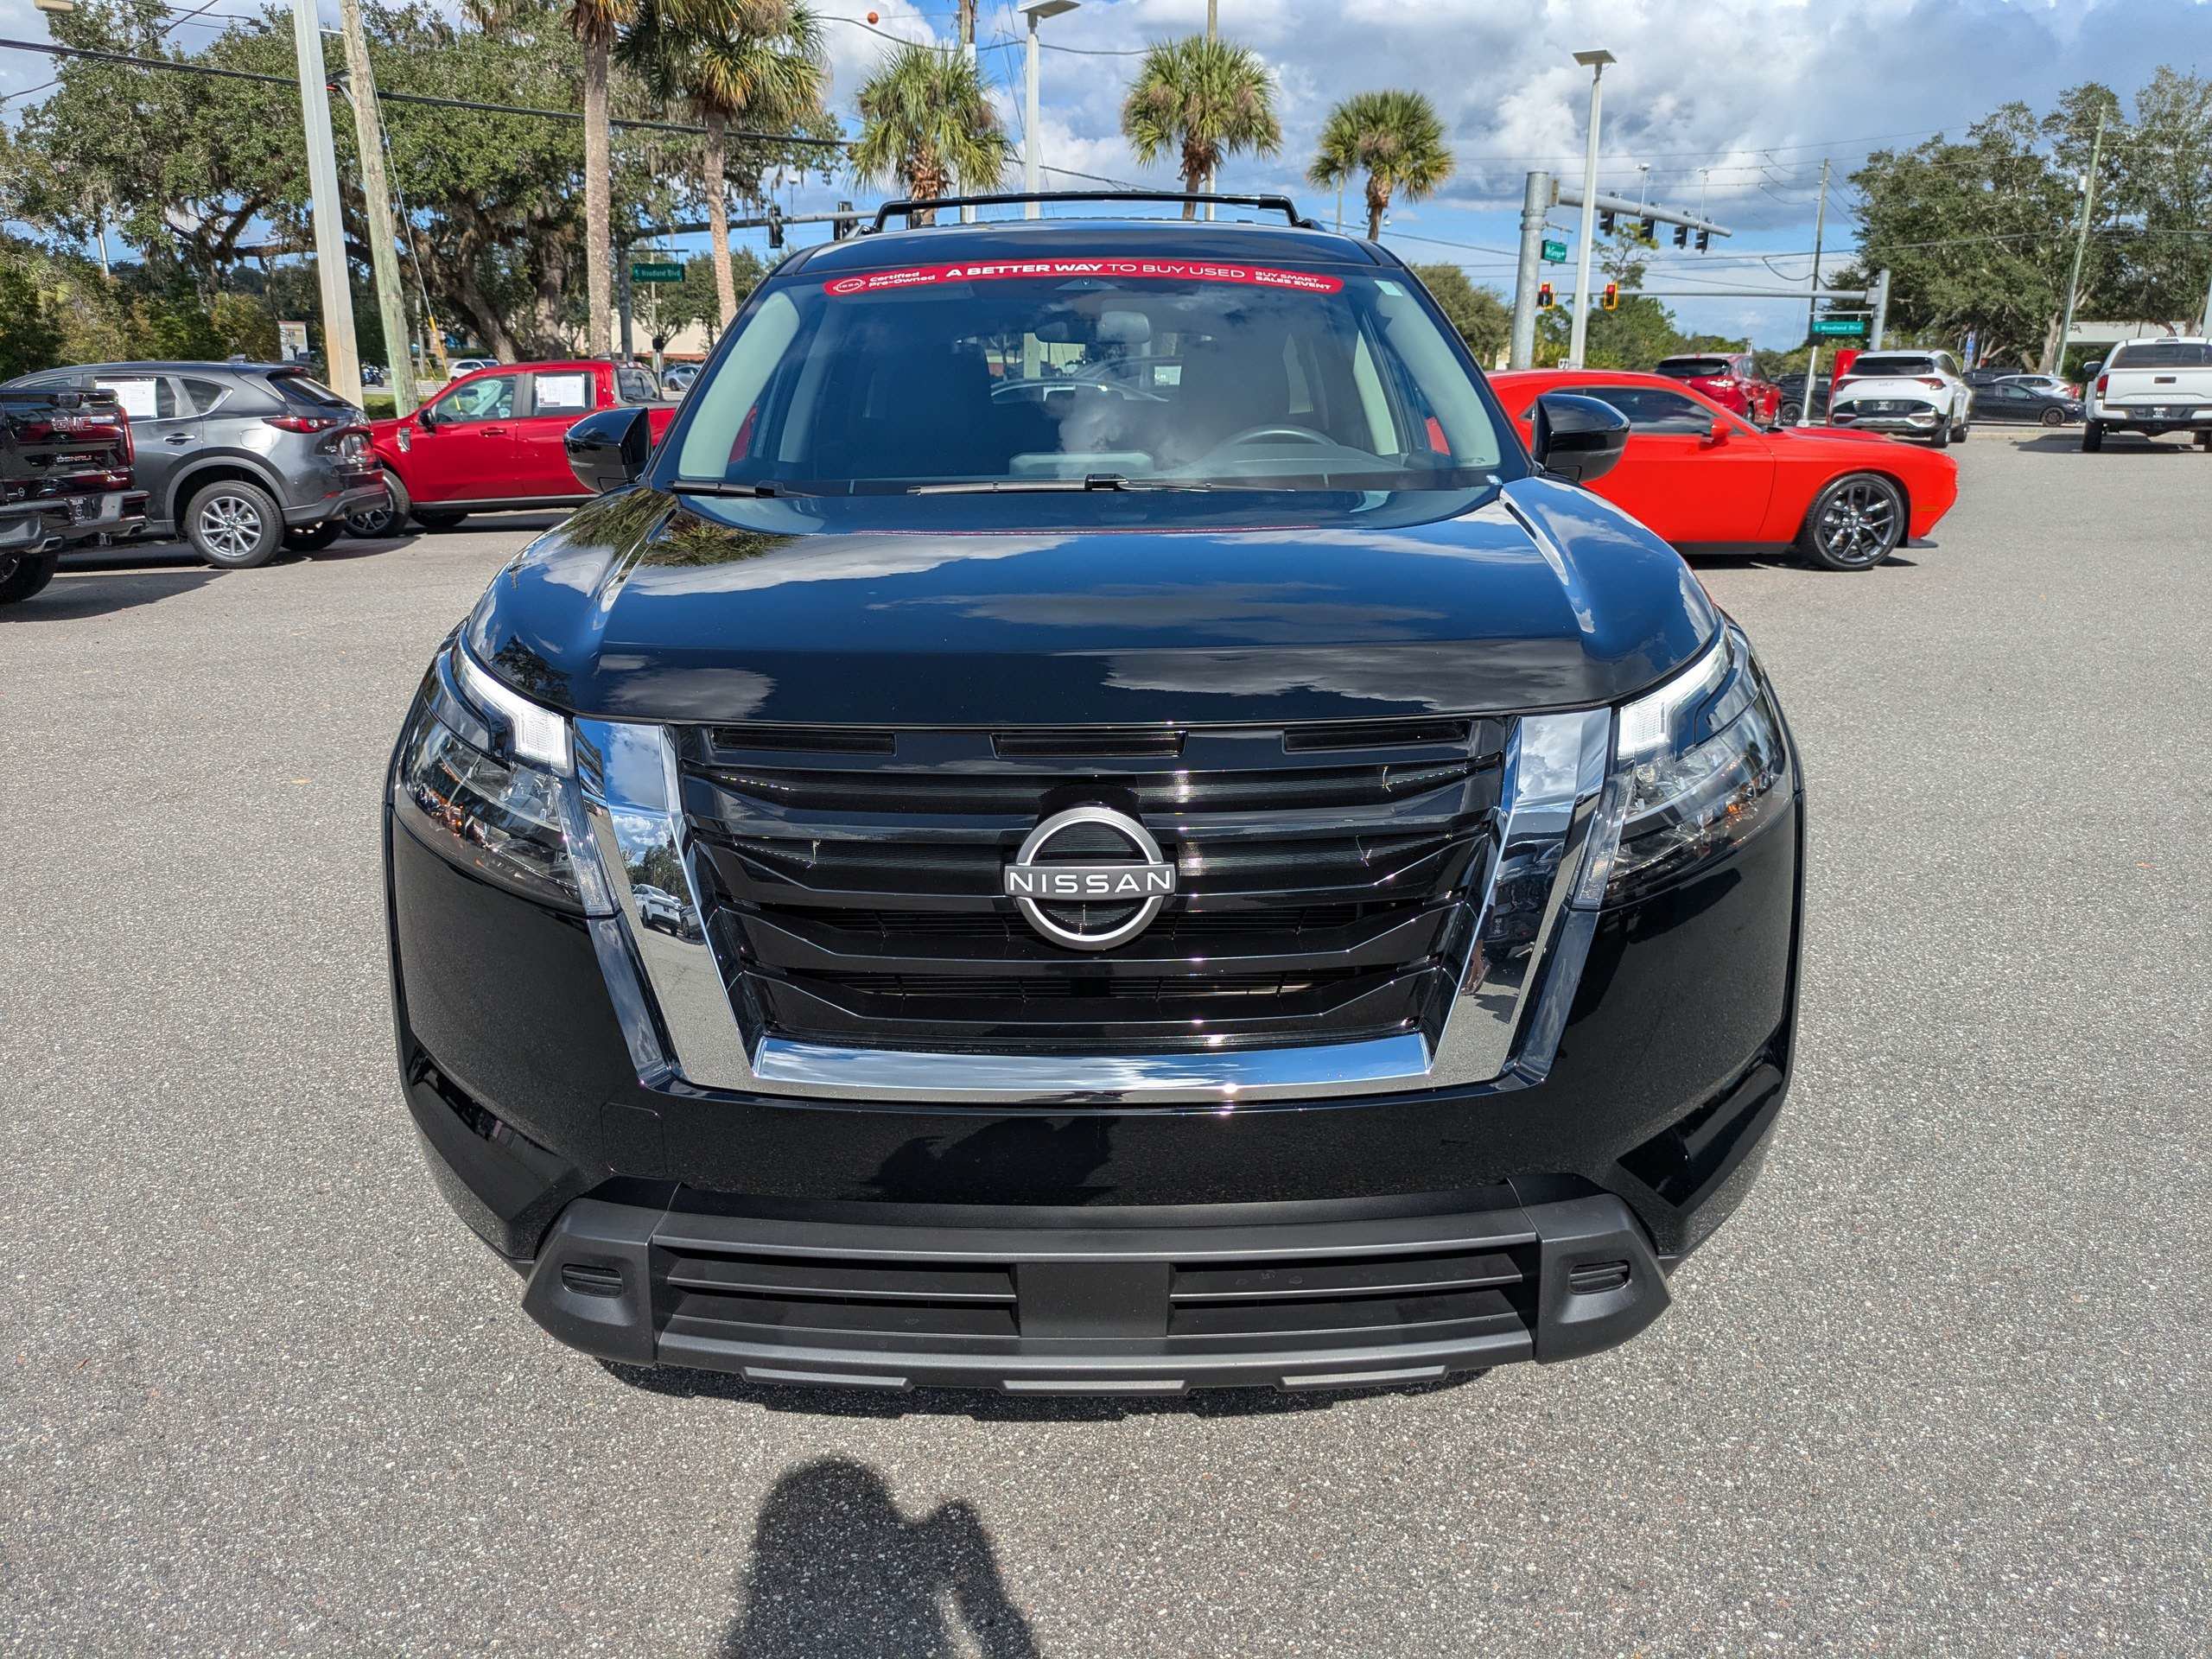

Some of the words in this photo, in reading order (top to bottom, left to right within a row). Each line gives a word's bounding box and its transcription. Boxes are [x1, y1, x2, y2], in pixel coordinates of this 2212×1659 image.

[869, 271, 920, 283] Certified
[945, 269, 963, 277] A
[967, 264, 1051, 276] BETTER
[1107, 264, 1137, 272] TO
[1142, 264, 1185, 274] BUY
[1189, 267, 1245, 278] USED
[868, 275, 936, 288] Pre-Owned
[1255, 276, 1292, 284] SALES
[1294, 280, 1332, 289] EVENT
[1281, 274, 1319, 283] SMART
[50, 416, 96, 432] GMC
[1009, 870, 1171, 893] NISSAN
